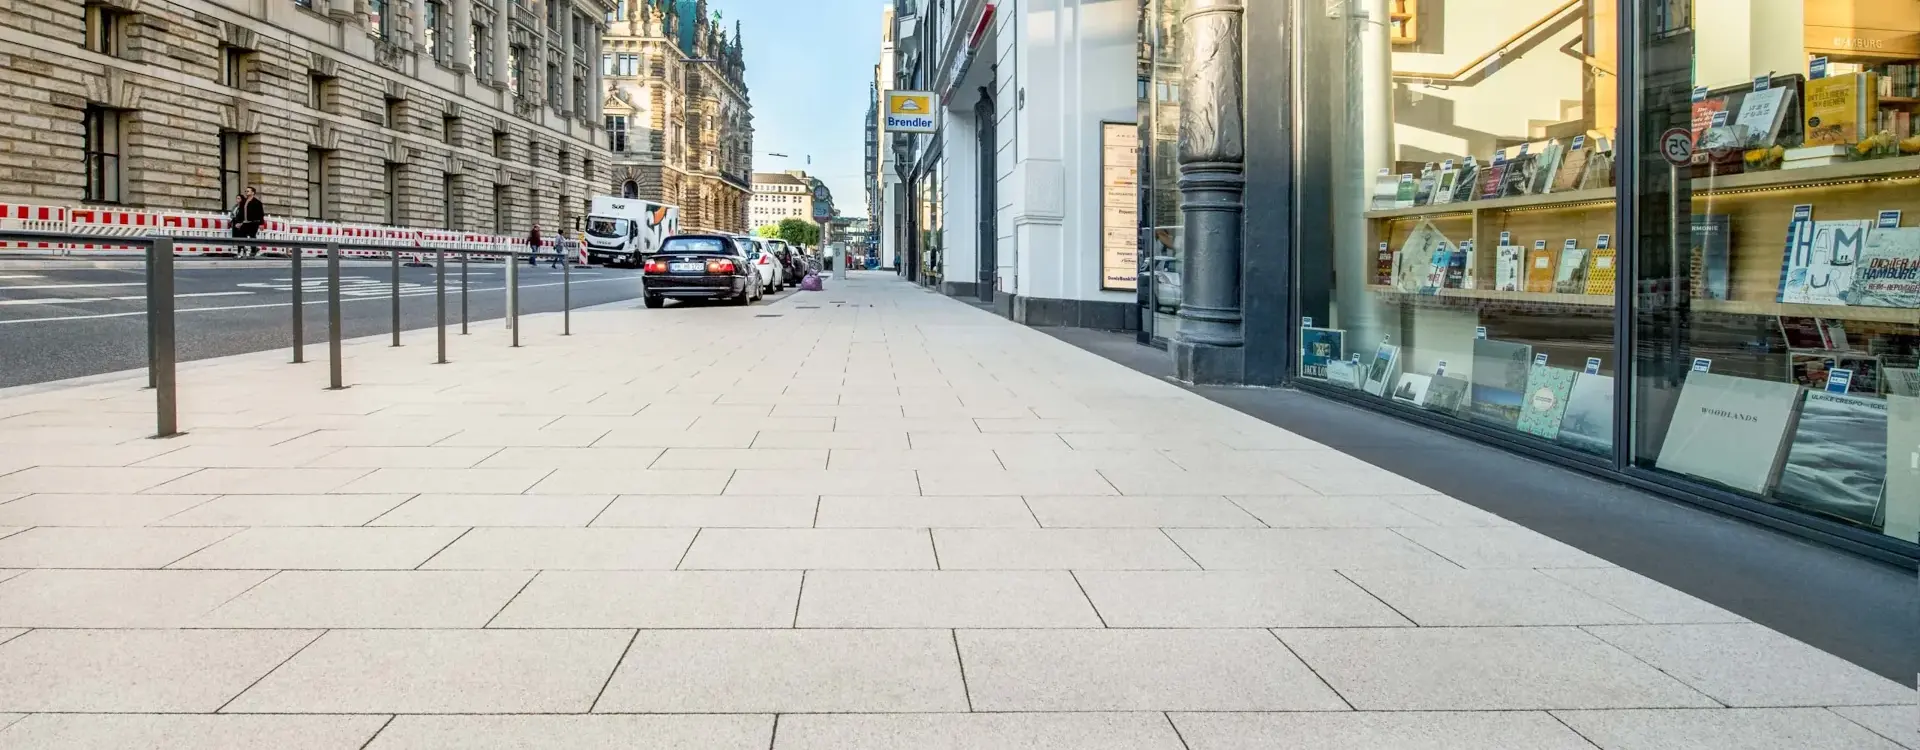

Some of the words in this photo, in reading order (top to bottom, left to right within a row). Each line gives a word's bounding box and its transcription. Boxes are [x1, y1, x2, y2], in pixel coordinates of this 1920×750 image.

[1833, 36, 1882, 48] HAMBURG
[888, 116, 932, 128] Brendler
[1870, 257, 1909, 268] DICHTER
[1862, 267, 1917, 279] HAMBURG
[1304, 364, 1317, 375] JACK
[1811, 393, 1835, 402] ULRIKE
[1835, 397, 1863, 406] CRESPO
[1870, 402, 1887, 410] ICEL
[1701, 407, 1758, 422] WOODLANDS
